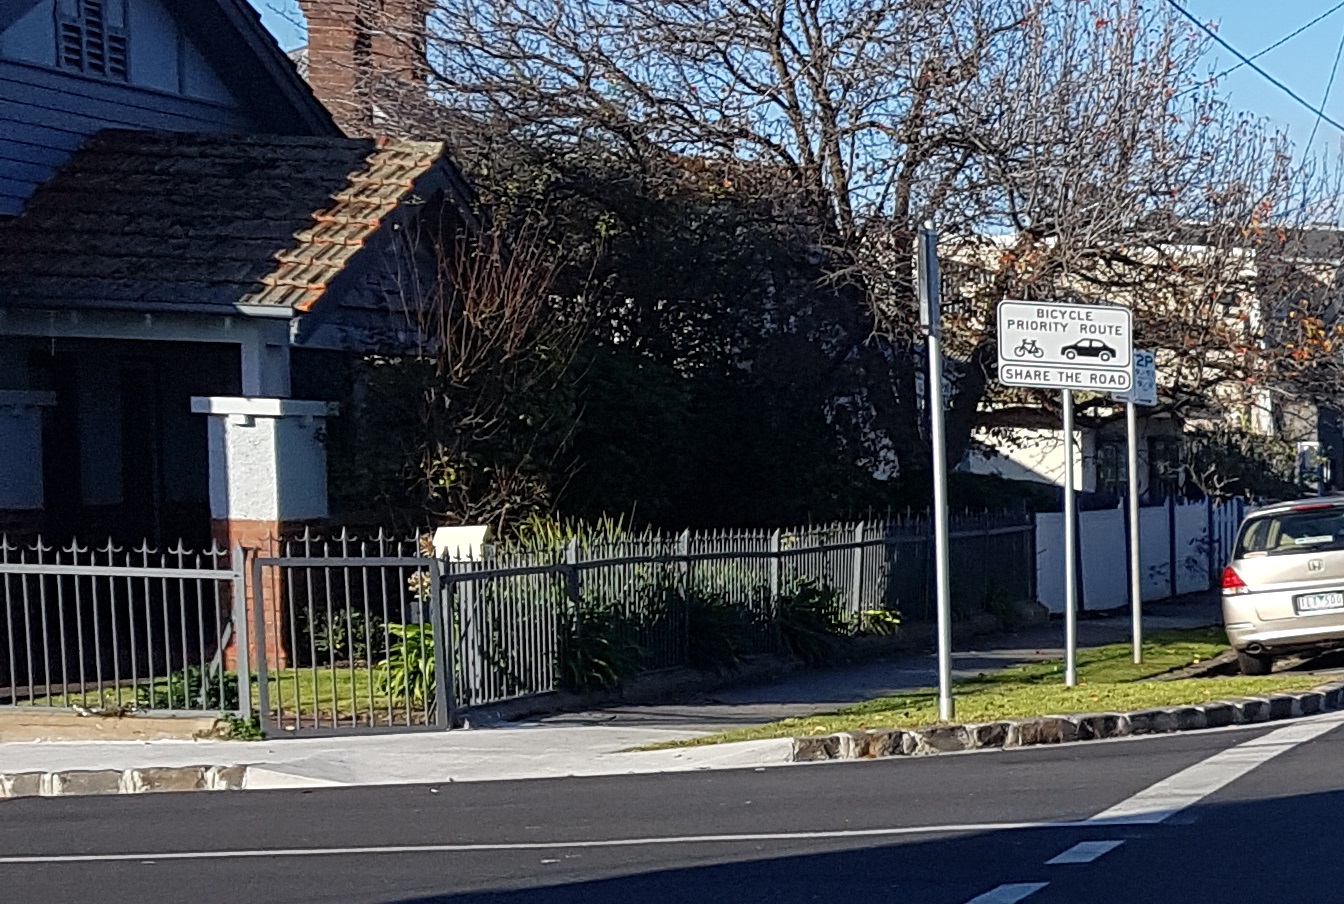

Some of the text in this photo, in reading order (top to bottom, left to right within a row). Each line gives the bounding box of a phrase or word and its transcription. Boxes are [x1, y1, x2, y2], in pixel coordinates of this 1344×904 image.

[1036, 308, 1094, 321] BICYCLE
[1007, 319, 1123, 336] PRIORITY ROUTE
[1136, 354, 1153, 367] 2P
[1005, 368, 1126, 385] SHARE THE ROAD
